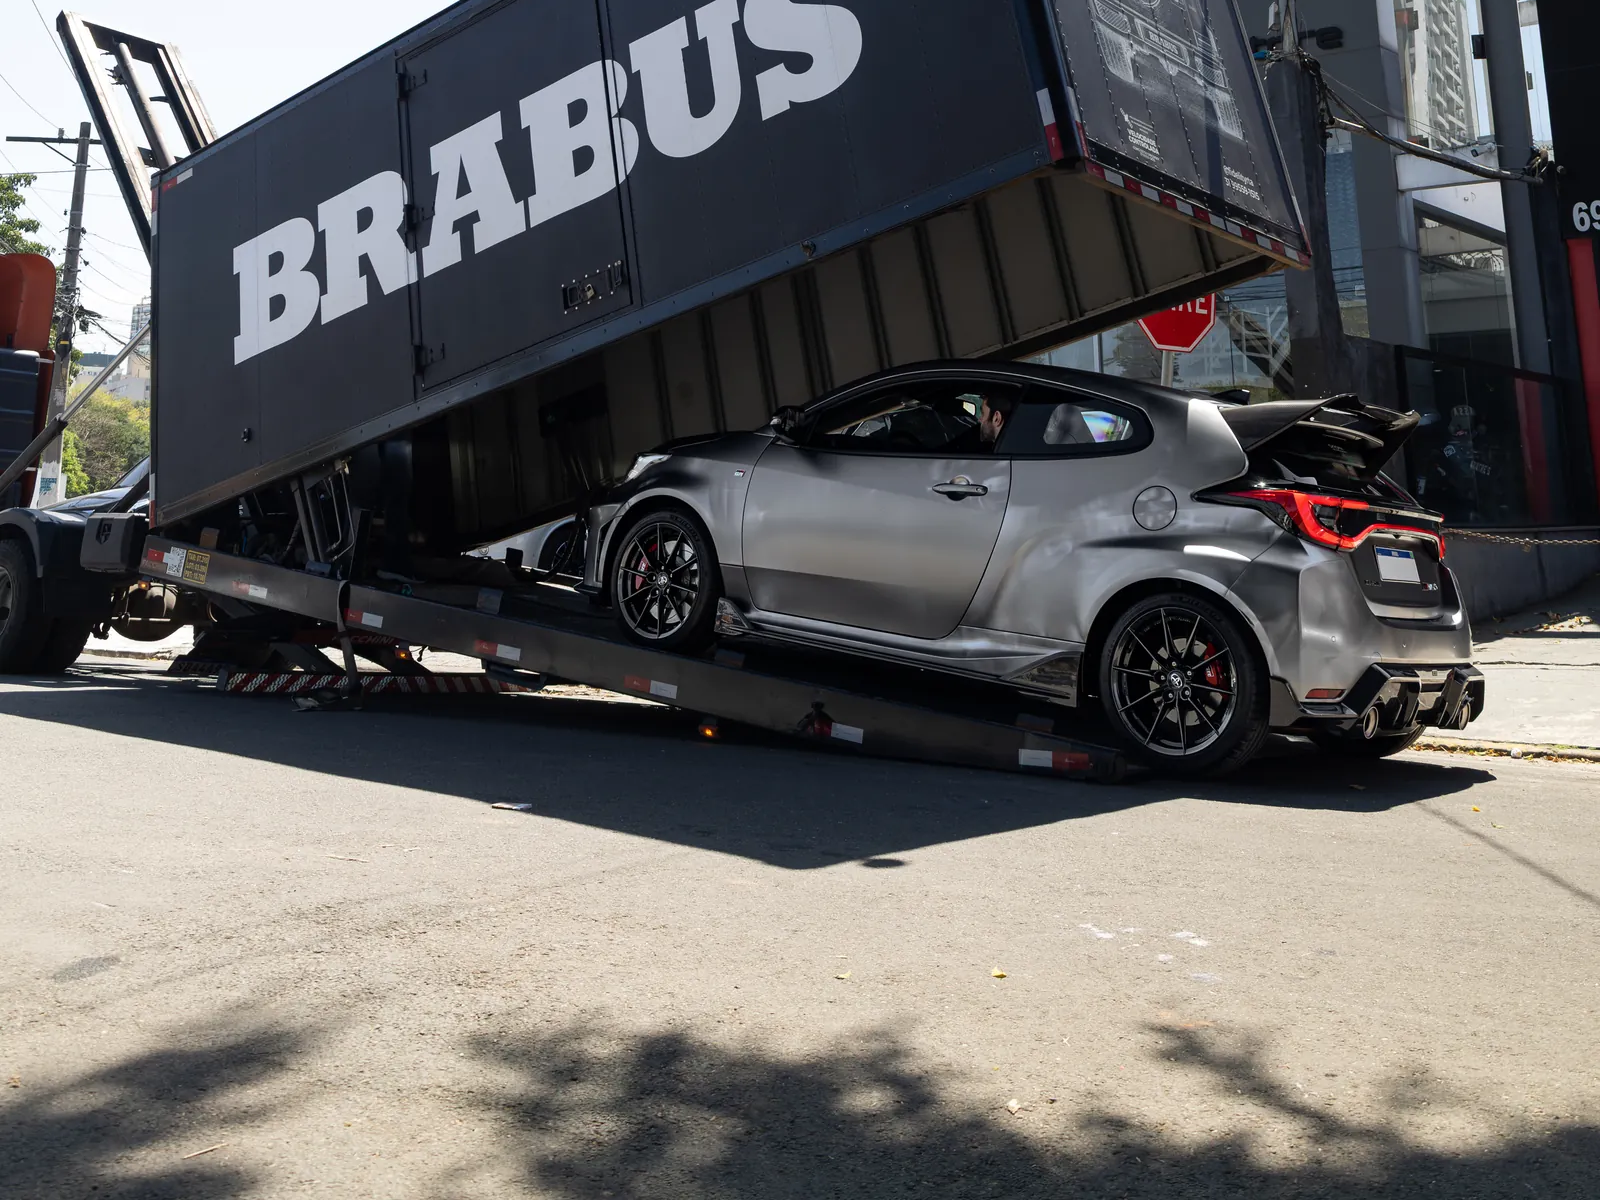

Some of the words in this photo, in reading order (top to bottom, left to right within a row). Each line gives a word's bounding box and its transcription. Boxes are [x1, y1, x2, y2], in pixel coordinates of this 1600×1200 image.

[1148, 30, 1179, 55] BRABUS
[1127, 128, 1157, 148] VELOCIDADE
[1128, 136, 1160, 155] CONTROLADA
